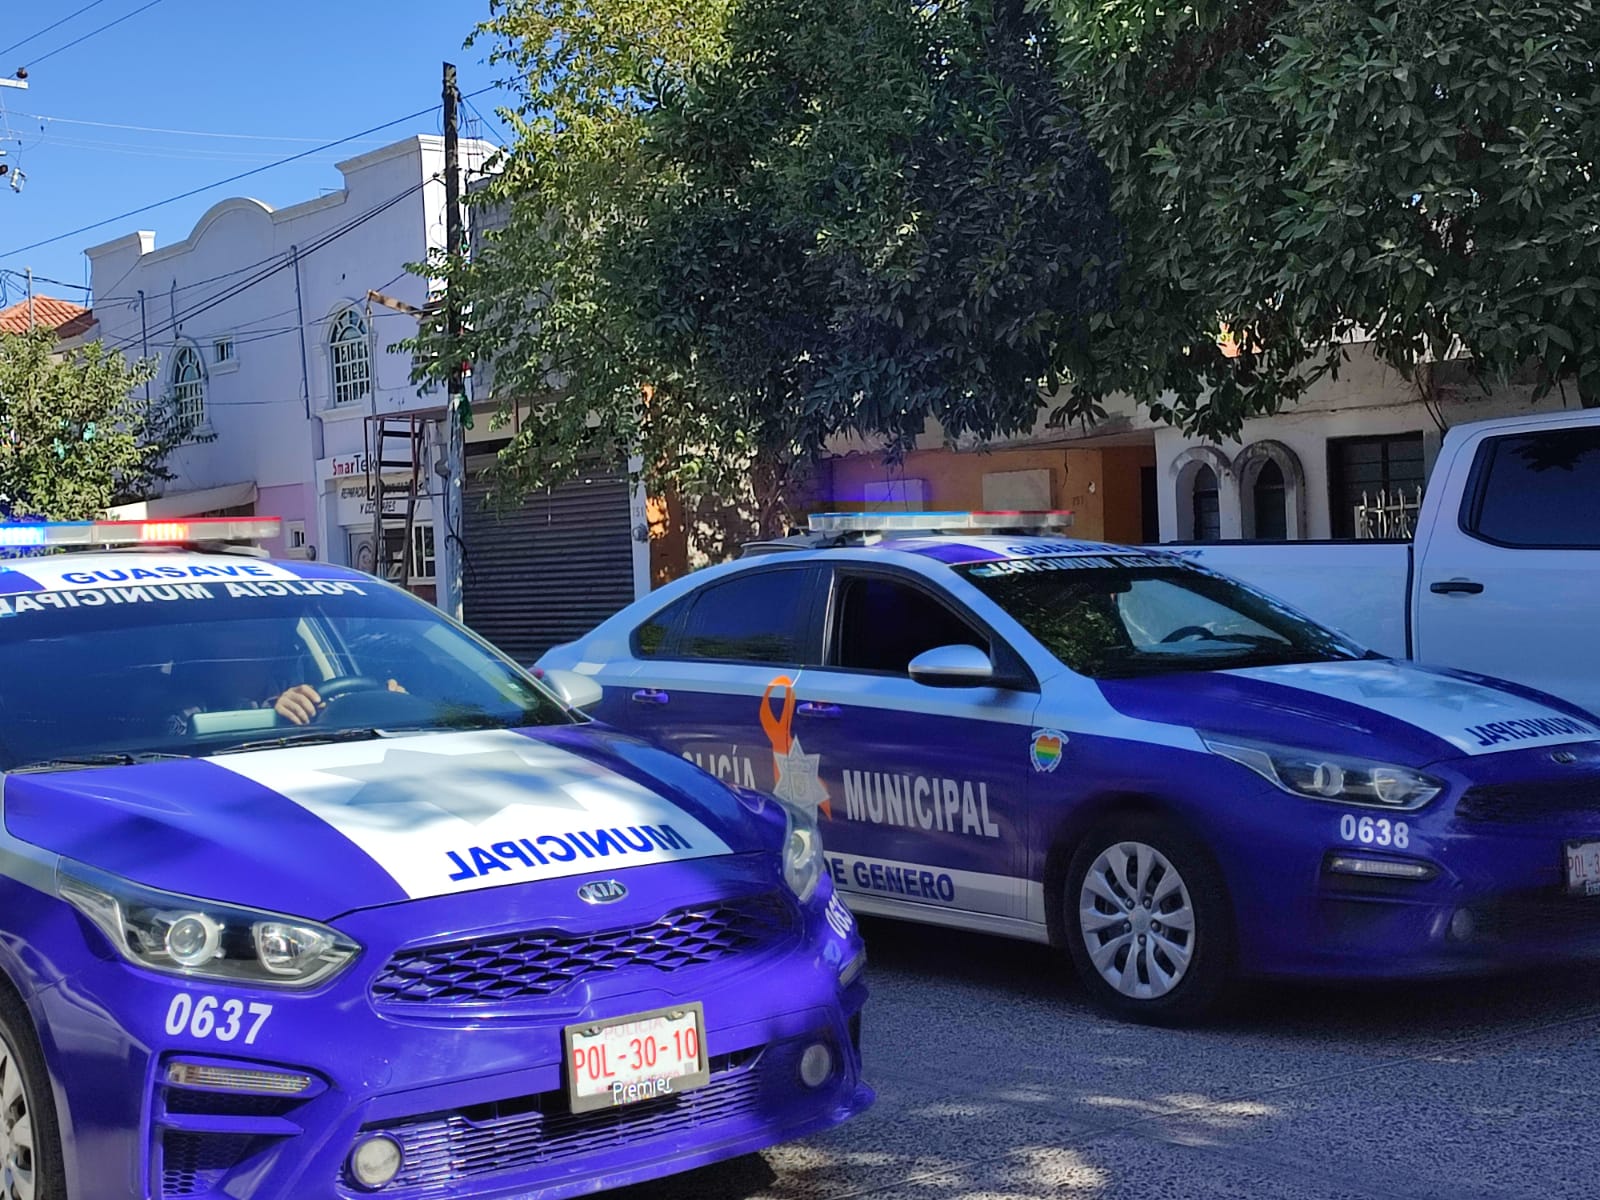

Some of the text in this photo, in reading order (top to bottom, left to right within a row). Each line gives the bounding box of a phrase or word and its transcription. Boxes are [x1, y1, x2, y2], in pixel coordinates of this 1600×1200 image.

[61, 565, 273, 585] GUASAVE
[843, 769, 999, 839] MUNICIPAL
[1340, 814, 1410, 849] 0638
[583, 881, 627, 902] KIA
[853, 861, 955, 902] GENERO
[165, 992, 273, 1045] 0637
[573, 1027, 698, 1084] POL-30-10
[612, 1076, 673, 1106] Premier
